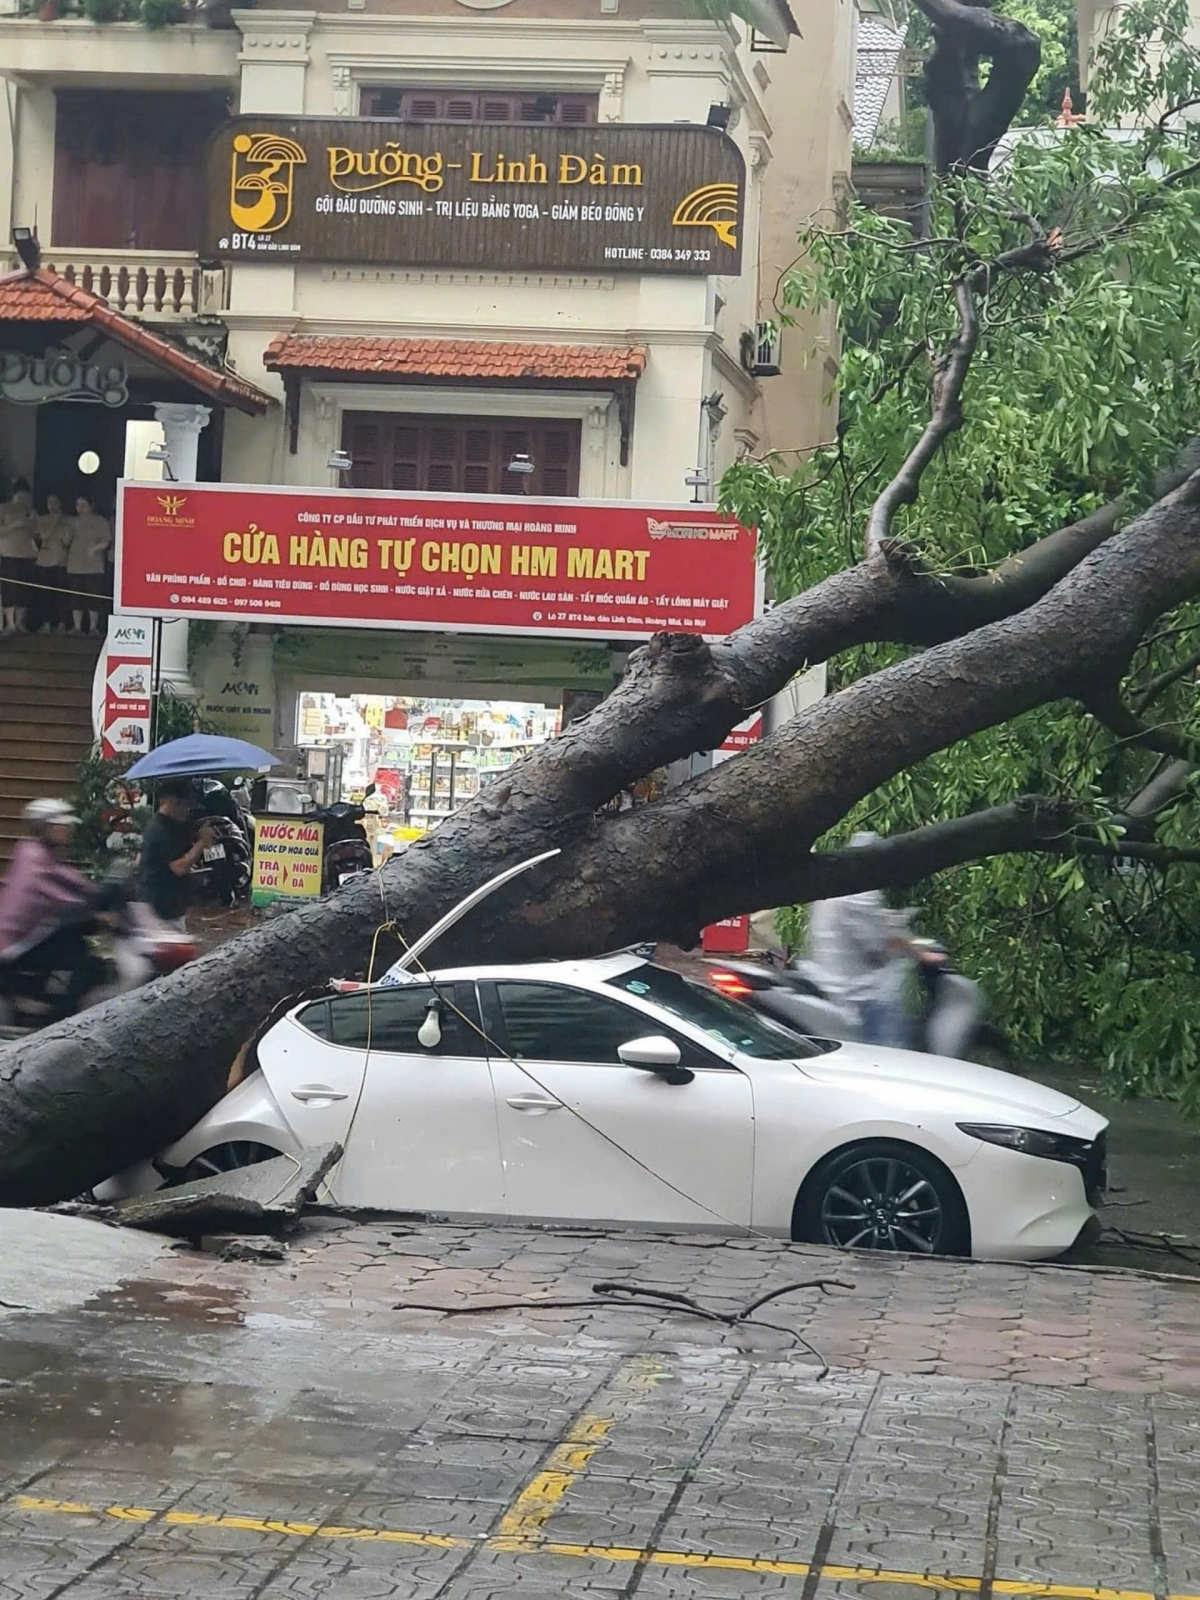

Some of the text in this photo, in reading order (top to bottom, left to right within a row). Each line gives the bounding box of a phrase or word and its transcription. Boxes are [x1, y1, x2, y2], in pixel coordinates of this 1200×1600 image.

[326, 141, 444, 192] Dưỡng
[469, 152, 549, 184] Linh
[557, 152, 644, 186] Đàm
[315, 194, 333, 215] GỘI
[336, 193, 357, 213] ĐẦU
[359, 195, 396, 215] DƯỠNG
[399, 200, 423, 216] SINH
[435, 200, 452, 220] TRỊ
[455, 197, 478, 220] LIỆU
[481, 194, 510, 218] BẰNG
[513, 203, 539, 219] YOGA
[551, 199, 578, 221] GIẢM
[581, 201, 602, 221] BÉO
[605, 202, 634, 222] ĐÔNG
[637, 207, 644, 222] Y
[232, 233, 256, 250] BT4
[650, 248, 673, 260] 0384
[674, 249, 691, 260] 349
[693, 250, 711, 261] 333
[298, 511, 320, 523] CÔNG
[322, 514, 332, 524] TY
[333, 514, 345, 524] CP
[365, 515, 376, 525] TƯ
[377, 514, 398, 526] PHÁT
[425, 518, 445, 530] DỊCH
[446, 519, 457, 531] VỤ
[459, 518, 470, 529] VÀ
[471, 520, 504, 531] THƯƠNG
[506, 522, 522, 533] MẠI
[524, 521, 552, 532] HOÀNG
[554, 524, 577, 534] MINH
[709, 529, 739, 541] MART
[223, 524, 651, 581] CỬA HÀNG TỰ CHỌN HM MART
[353, 583, 369, 594] HỌC
[417, 586, 434, 597] GIẶT
[541, 592, 556, 601] LAU
[711, 598, 729, 610] GIẶT
[259, 823, 319, 842] NƯỚC MÍA
[288, 847, 303, 856] HOA
[258, 860, 280, 871] TRÀ
